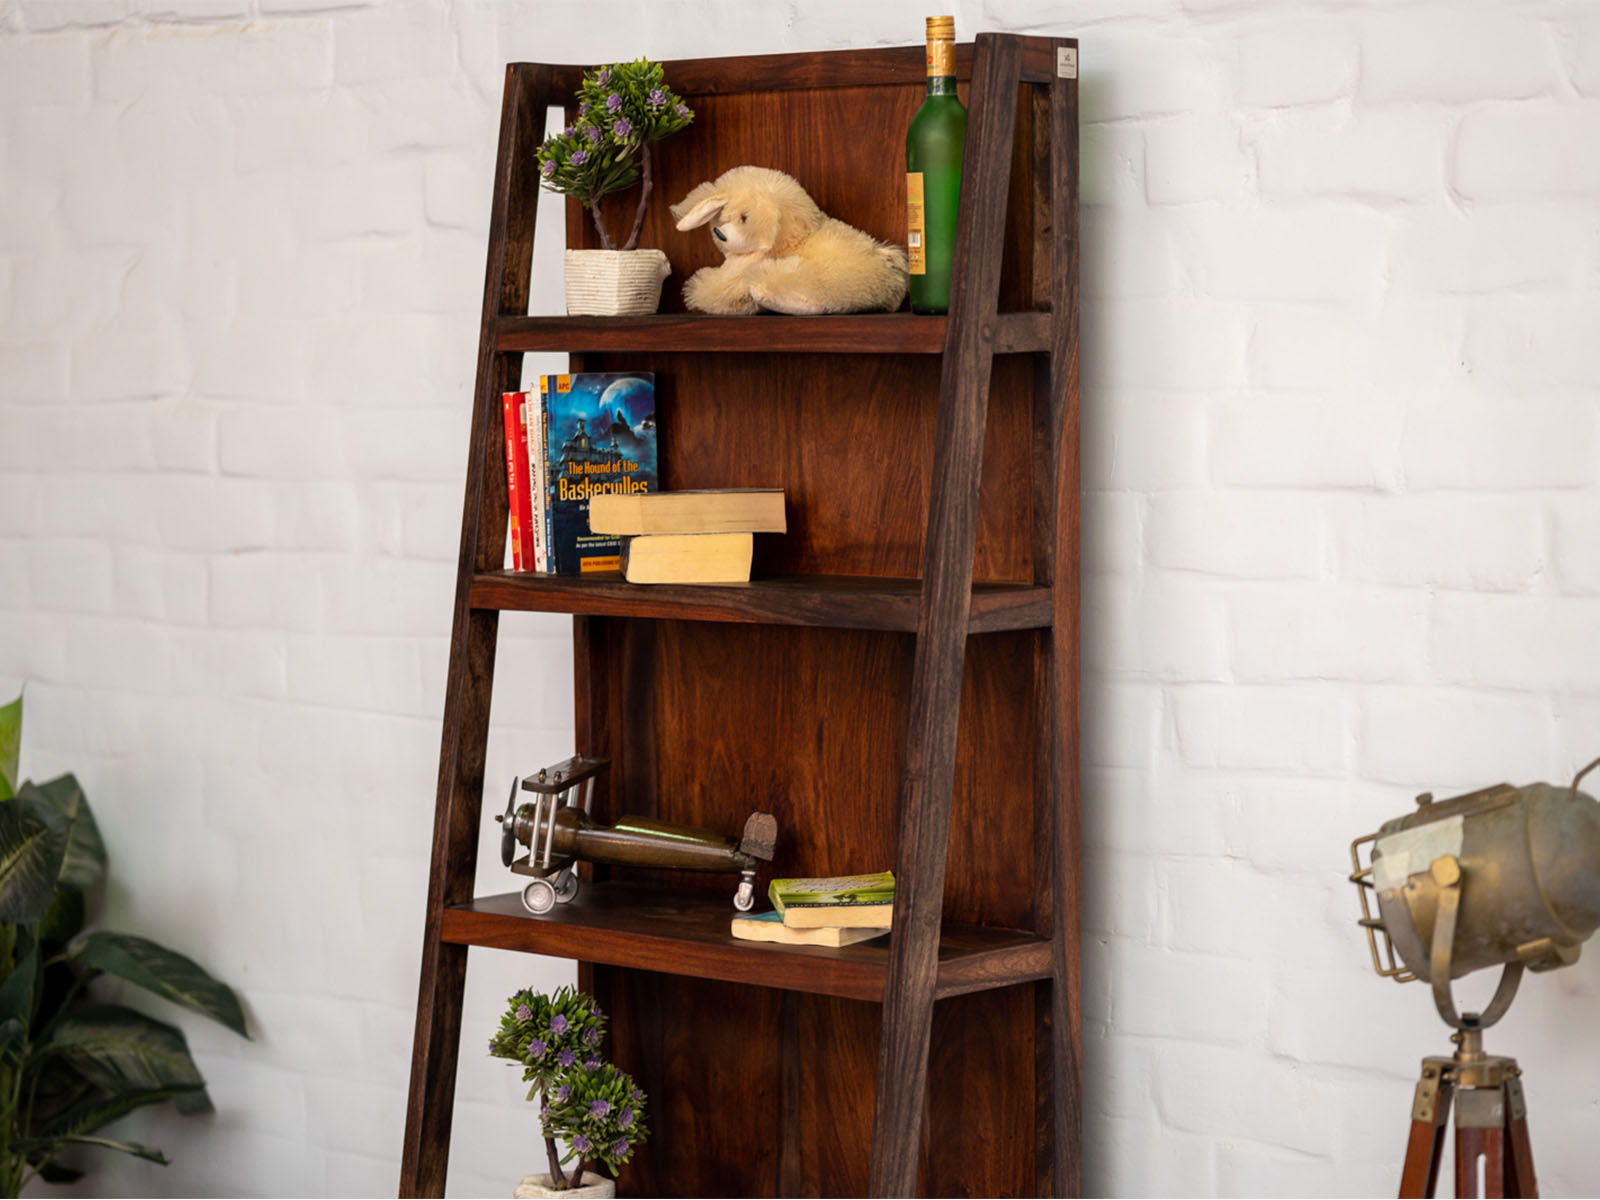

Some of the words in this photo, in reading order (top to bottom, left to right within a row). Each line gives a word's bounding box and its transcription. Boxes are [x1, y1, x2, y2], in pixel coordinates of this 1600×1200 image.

[568, 461, 583, 475] The
[584, 460, 611, 474] Hound
[612, 459, 622, 473] of
[623, 459, 638, 473] the
[560, 476, 648, 501] Baskervilles
